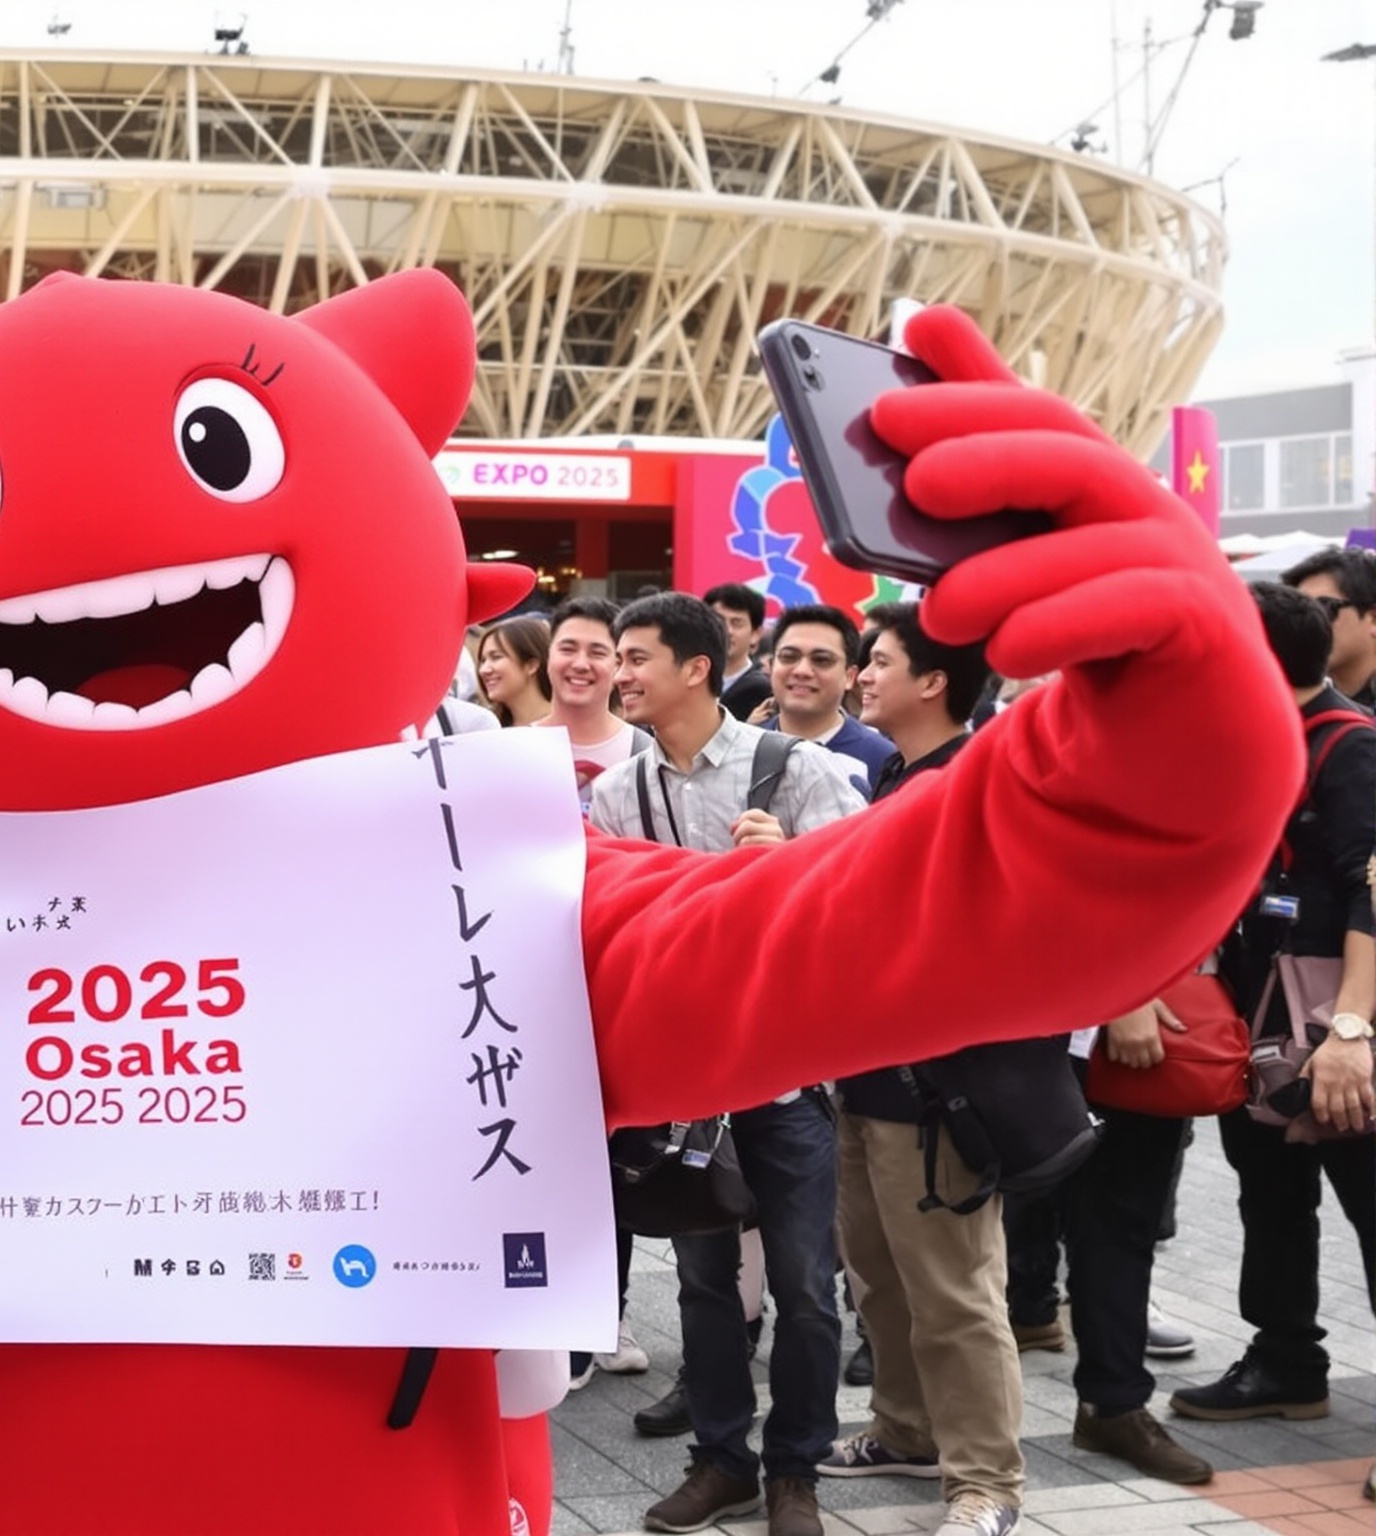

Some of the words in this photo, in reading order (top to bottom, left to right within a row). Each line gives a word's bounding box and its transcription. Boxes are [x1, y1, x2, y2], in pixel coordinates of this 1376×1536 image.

[472, 463, 549, 486] EXPO
[556, 466, 619, 488] 2025
[27, 957, 246, 1025] 2025
[25, 1028, 243, 1082] Osaka
[20, 1087, 124, 1126] 2025
[137, 1085, 247, 1124] 2025
